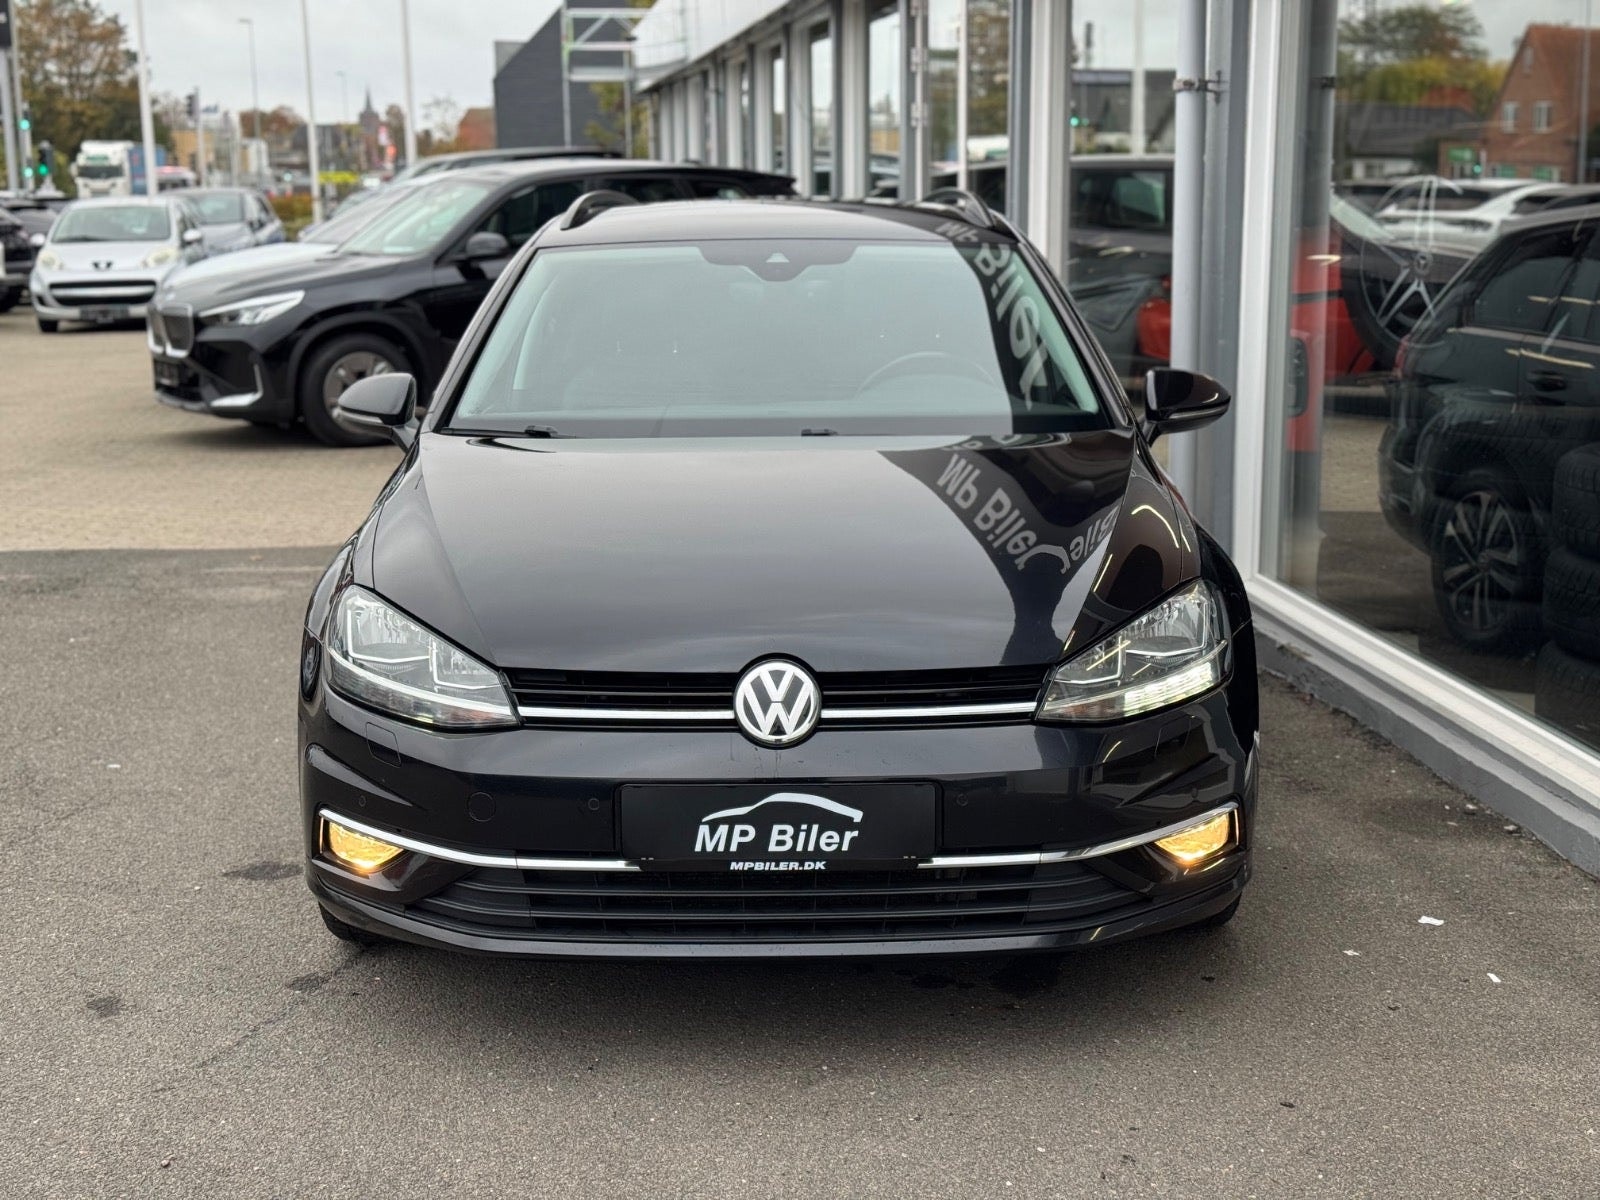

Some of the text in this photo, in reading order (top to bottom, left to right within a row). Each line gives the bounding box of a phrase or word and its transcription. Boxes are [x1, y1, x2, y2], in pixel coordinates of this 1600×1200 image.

[738, 664, 815, 739] VW
[694, 824, 859, 852] MP Biler
[730, 861, 827, 871] MPBILER.DK
